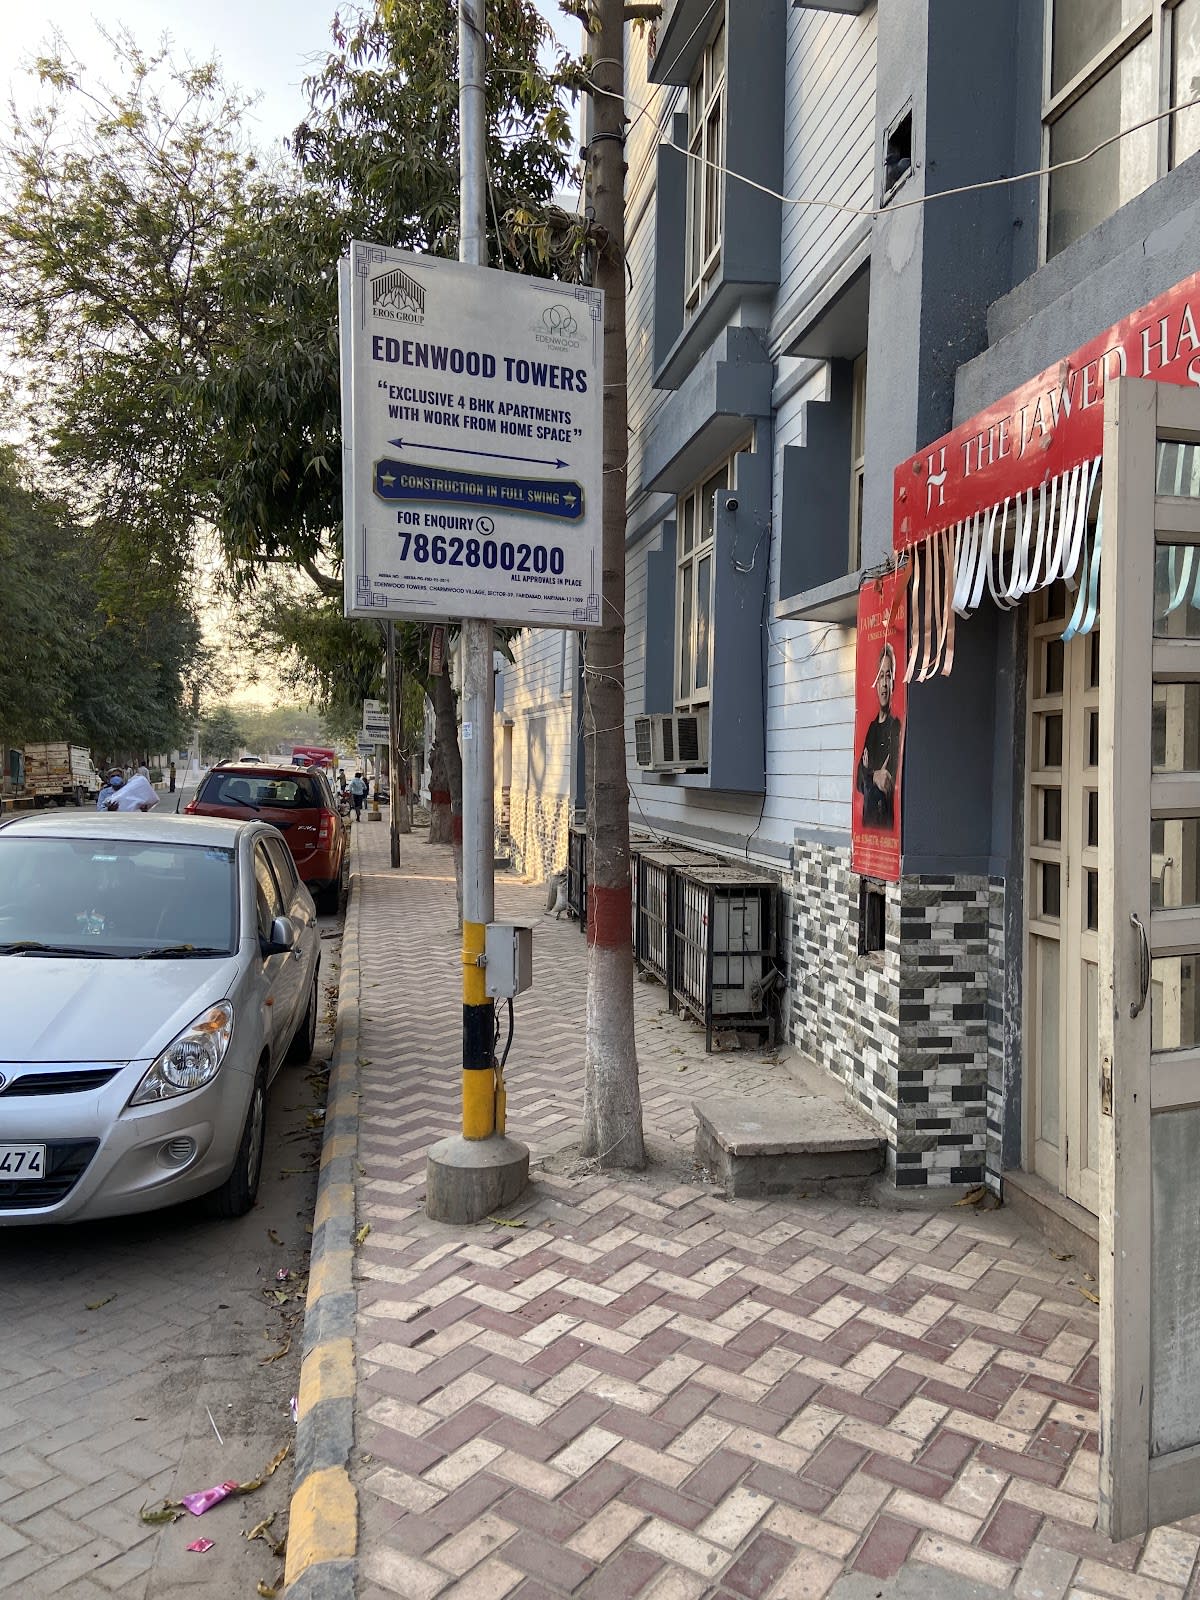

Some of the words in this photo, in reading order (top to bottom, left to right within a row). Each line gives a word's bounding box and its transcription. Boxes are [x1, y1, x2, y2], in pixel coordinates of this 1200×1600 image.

[373, 307, 394, 320] EROS
[396, 310, 424, 324] GROUP
[536, 334, 580, 348] EDENWOOD
[372, 335, 496, 379] EDENWOOD
[504, 357, 588, 394] TOWERS
[388, 404, 420, 422] WITH
[424, 409, 460, 428] WORK
[464, 415, 496, 432] FROM
[500, 420, 533, 438] HOME
[458, 396, 466, 410] 4
[469, 397, 494, 414] BHK
[498, 402, 572, 425] APARTMENTS
[960, 416, 1012, 478] THE
[1017, 345, 1127, 460] JAWED
[400, 474, 484, 496] CONSTRUCTION
[486, 485, 498, 498] IN
[500, 488, 525, 501] FULL
[527, 490, 560, 505] SWING
[398, 511, 420, 526] FOR
[424, 514, 474, 531] ENQUIRY
[398, 532, 564, 574] 7862800200
[429, 586, 464, 594] CHARMWOOD
[510, 574, 521, 582] ALL
[522, 575, 556, 585] APPROVALS
